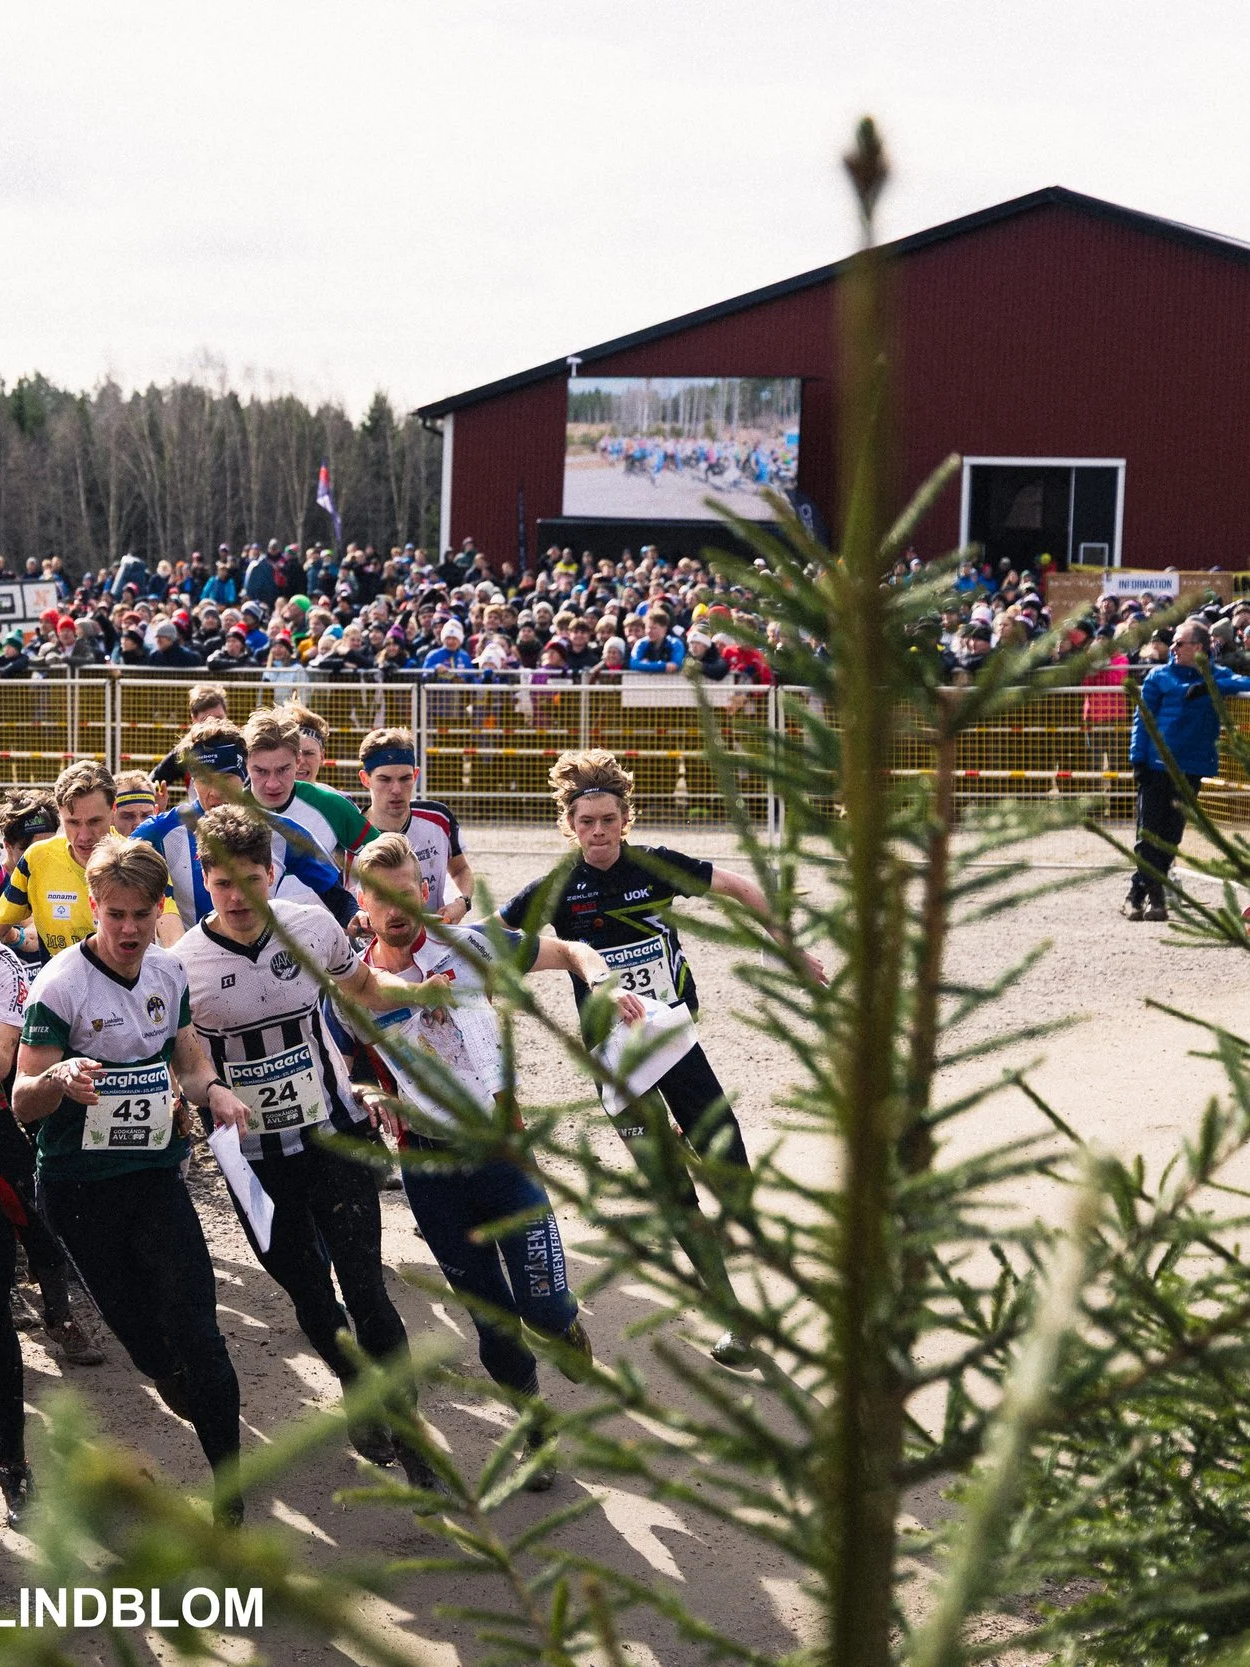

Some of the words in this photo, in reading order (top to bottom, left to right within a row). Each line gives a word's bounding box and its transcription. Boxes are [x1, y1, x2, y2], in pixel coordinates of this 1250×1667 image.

[1118, 579, 1173, 590] INFORMATION
[47, 893, 78, 901] noname
[623, 888, 650, 901] UOK
[467, 934, 493, 962] headlight
[657, 961, 663, 969] 1
[620, 967, 651, 991] 33
[230, 1048, 310, 1079] bagheera
[306, 1071, 313, 1081] 1
[162, 1095, 167, 1105] 1
[258, 1080, 299, 1108] 24
[112, 1098, 151, 1122] 43
[524, 1229, 551, 1298] BYÅSEN
[546, 1213, 566, 1292] ORIENTERING
